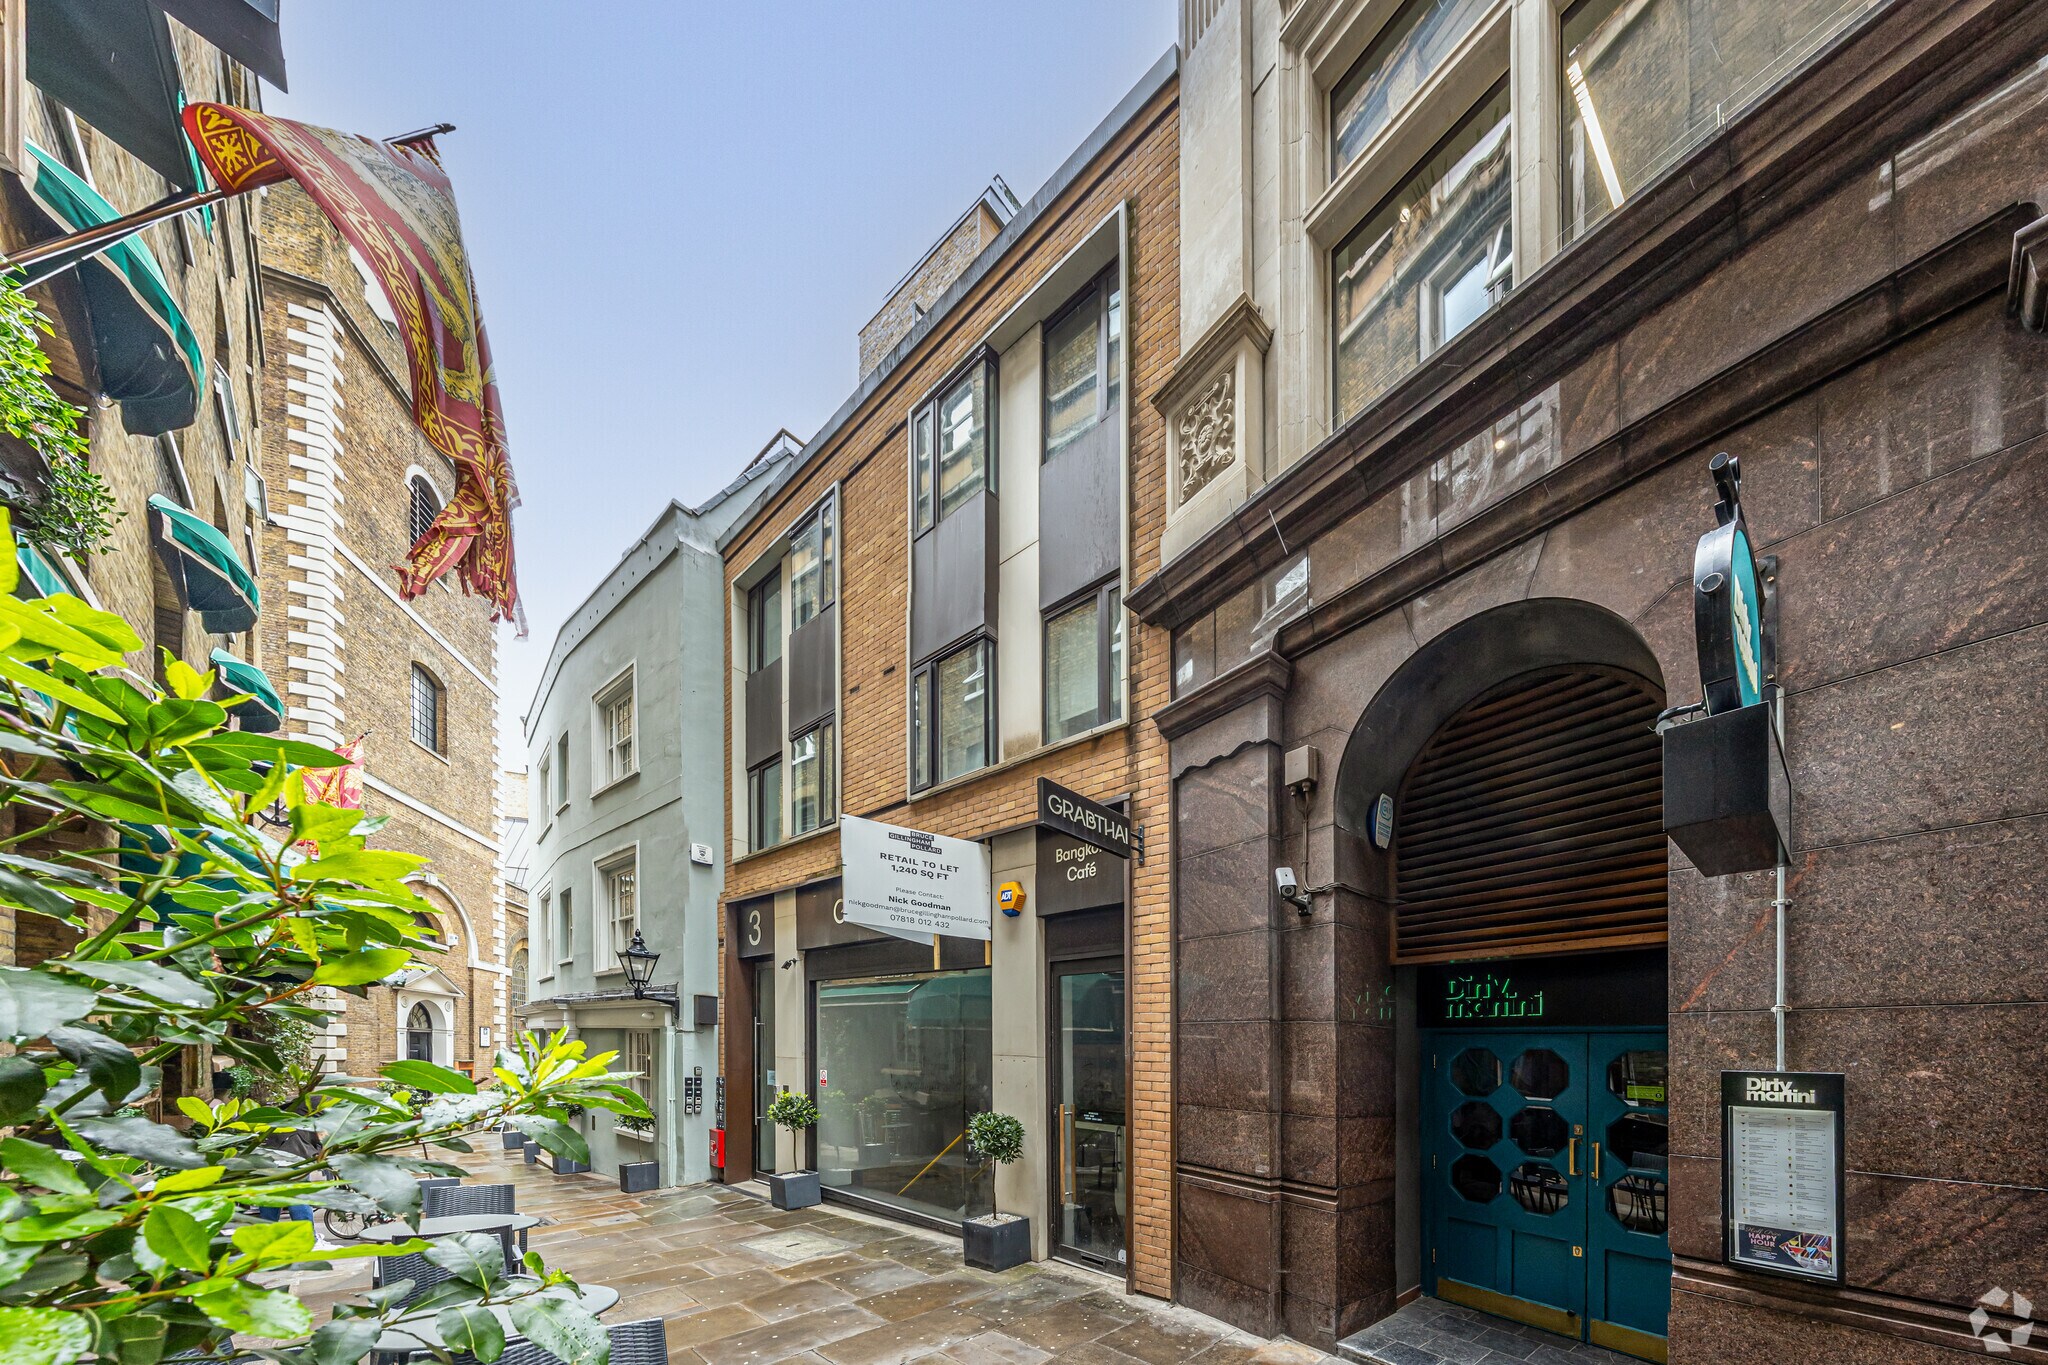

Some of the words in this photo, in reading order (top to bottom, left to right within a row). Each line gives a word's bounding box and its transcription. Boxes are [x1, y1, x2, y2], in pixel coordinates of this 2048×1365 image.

[1048, 794, 1128, 844] GRABTHAI
[890, 833, 931, 846] GILLINGHAM
[911, 832, 934, 841] BRUCE
[911, 844, 941, 854] POLLARD
[1056, 844, 1102, 863] Bangko
[880, 852, 918, 866] RETAIL
[922, 860, 936, 869] TO
[940, 864, 960, 873] LET
[890, 864, 918, 876] 1,240
[920, 870, 934, 880] SQ
[936, 873, 950, 881] FT
[1067, 862, 1096, 882] Café
[896, 887, 916, 896] Please
[918, 890, 944, 900] Contact:
[1001, 892, 1012, 900] ADT
[888, 896, 908, 905] Nick
[910, 898, 951, 911] Goodman
[748, 910, 762, 946] 3
[890, 914, 915, 924] 07818
[918, 918, 932, 926] 012
[934, 920, 950, 928] 432
[1746, 1078, 1792, 1092] Dirty
[1746, 1089, 1816, 1104] martini
[1748, 1232, 1776, 1242] HAPPY
[1750, 1238, 1776, 1248] HOUR
